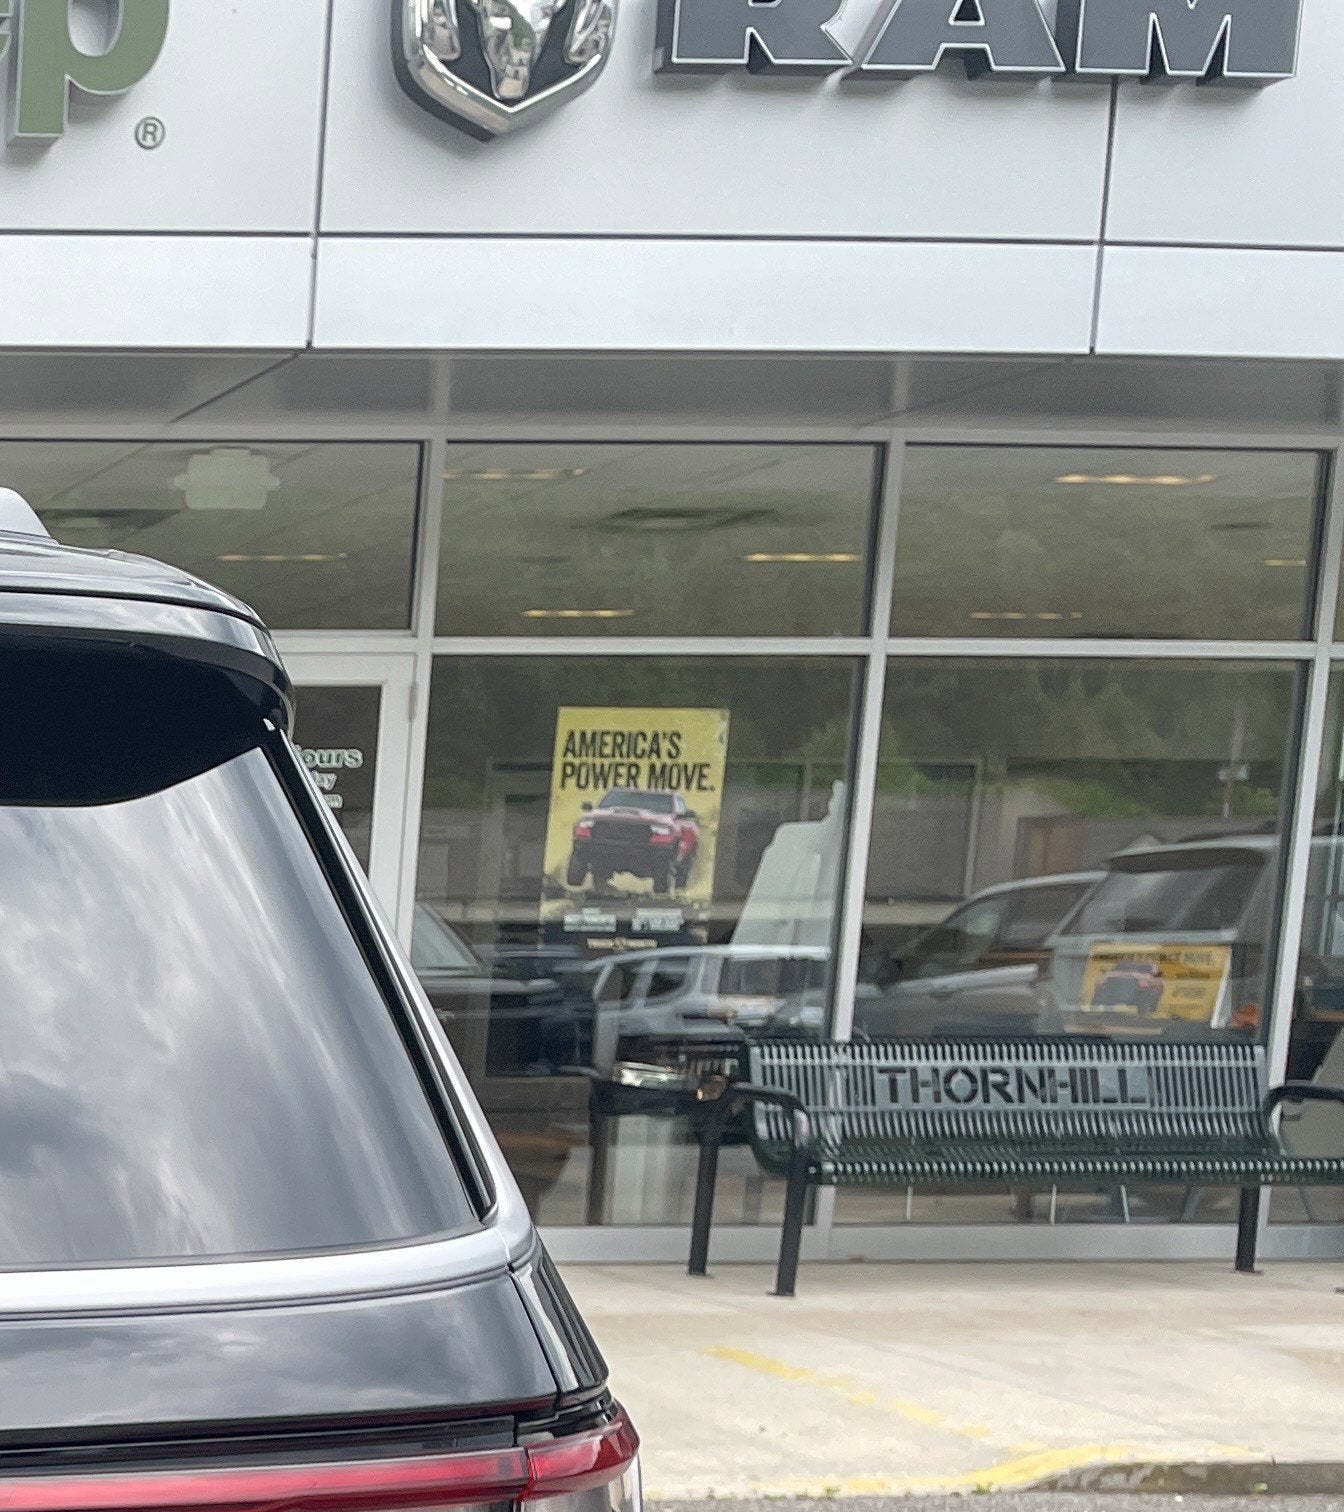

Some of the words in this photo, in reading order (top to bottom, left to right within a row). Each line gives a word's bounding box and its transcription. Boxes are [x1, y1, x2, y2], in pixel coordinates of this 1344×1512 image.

[295, 745, 363, 768] ours
[562, 729, 683, 760] AMERICA'S
[561, 761, 641, 790] POWER
[648, 763, 716, 792] MOVE.
[878, 1066, 1147, 1104] THORNHILL
